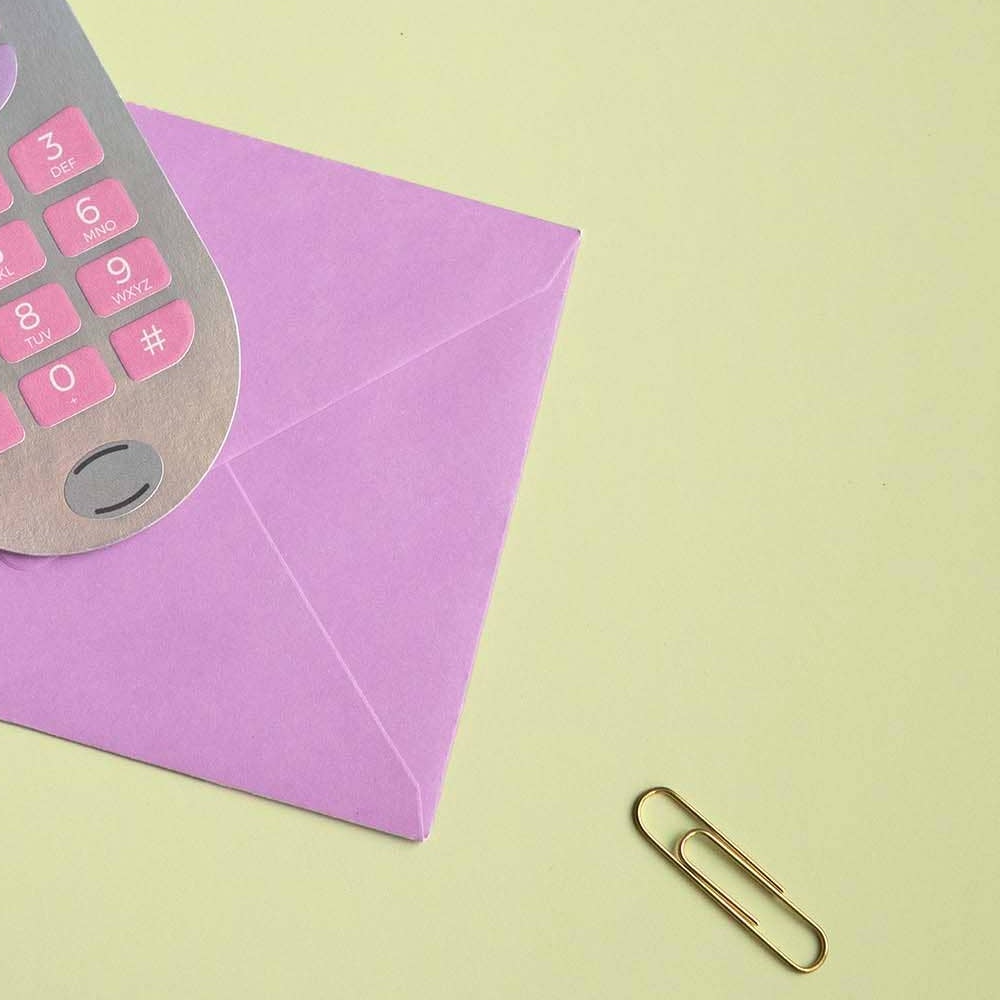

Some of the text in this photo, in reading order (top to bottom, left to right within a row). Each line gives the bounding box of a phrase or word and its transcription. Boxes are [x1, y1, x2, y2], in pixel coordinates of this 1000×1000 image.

[38, 132, 63, 161] 3
[50, 158, 77, 179] DEF
[76, 197, 100, 225] 6
[83, 220, 117, 243] MNO
[106, 256, 131, 284] 9
[111, 279, 152, 306] WXYZ
[14, 302, 40, 330] 8
[24, 329, 52, 348] TUV
